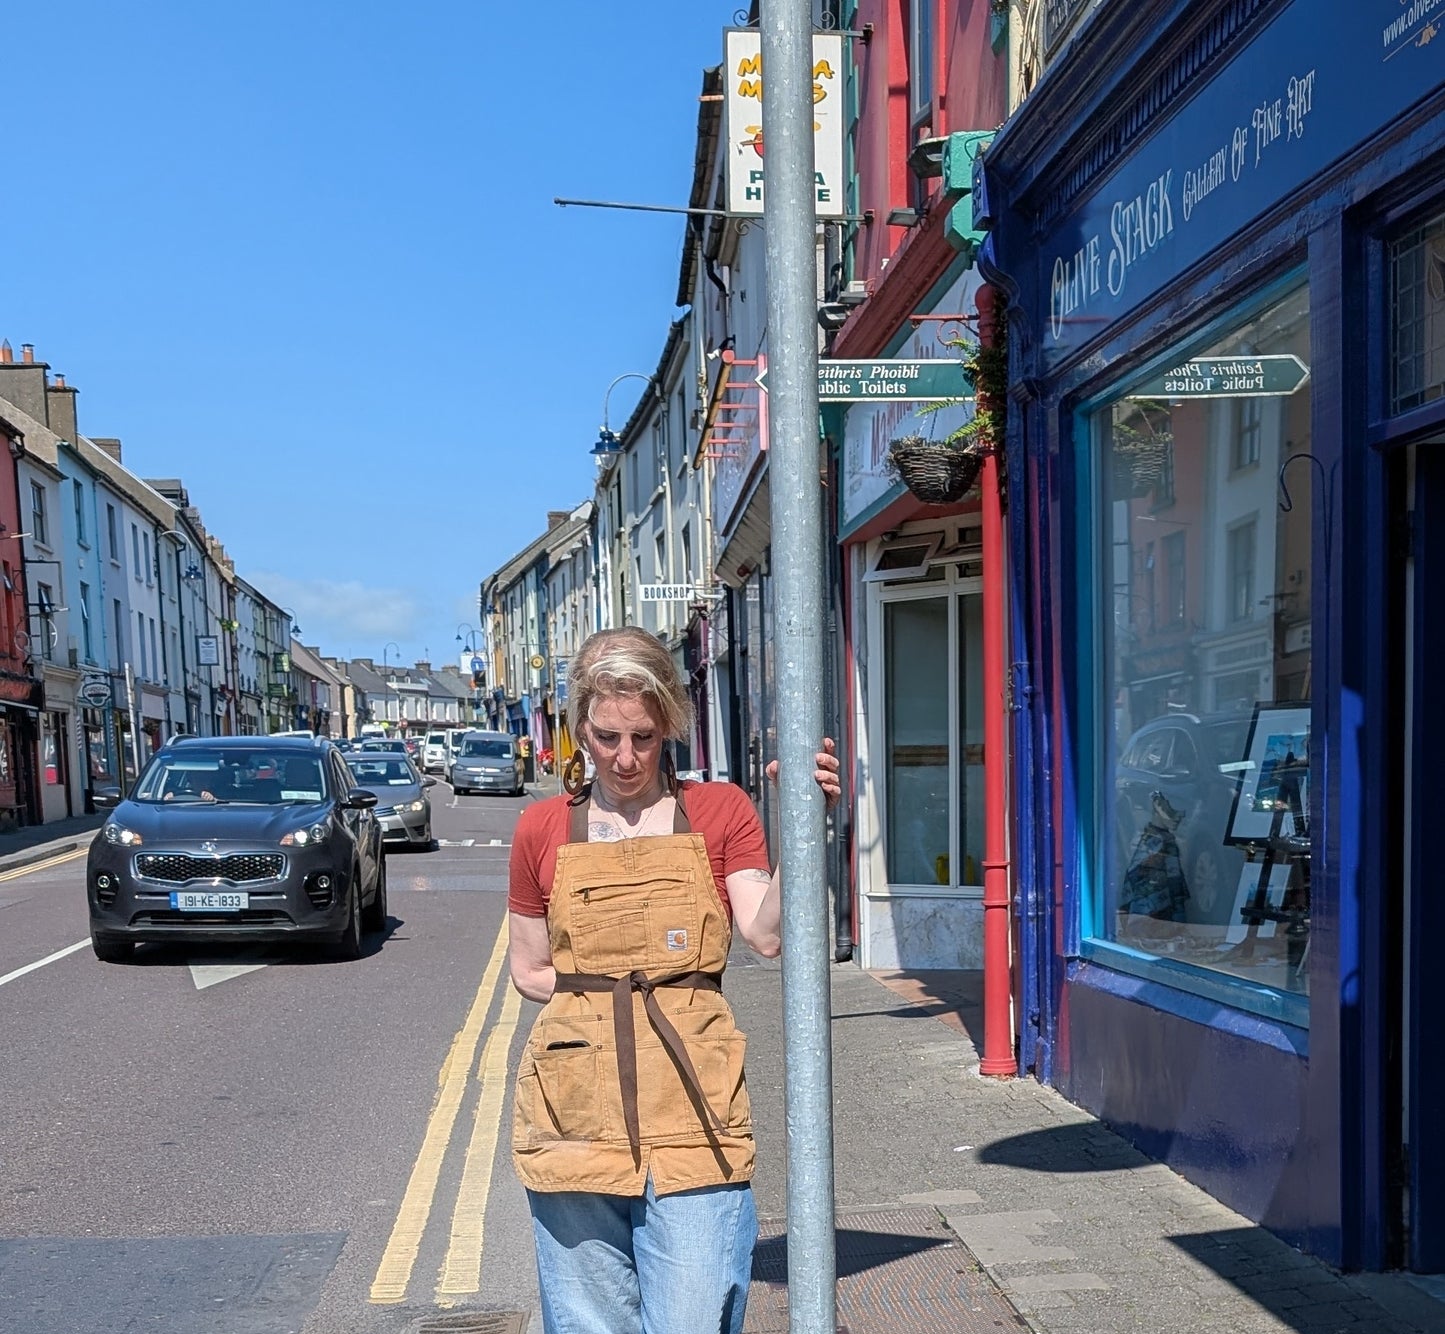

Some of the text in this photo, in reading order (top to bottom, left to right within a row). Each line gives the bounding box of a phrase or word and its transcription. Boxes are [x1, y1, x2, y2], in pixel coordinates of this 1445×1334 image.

[1383, 0, 1444, 47] www.olive
[737, 53, 834, 80] MA
[737, 79, 827, 104] MS
[1051, 69, 1315, 340] OLIVE STACK GALLERY OF FINE ART
[818, 365, 920, 379] eithris Phoiblí
[818, 380, 907, 394] ublic Toilets
[644, 586, 690, 599] BOOKSHOP
[184, 896, 241, 907] 191-KE-1833
